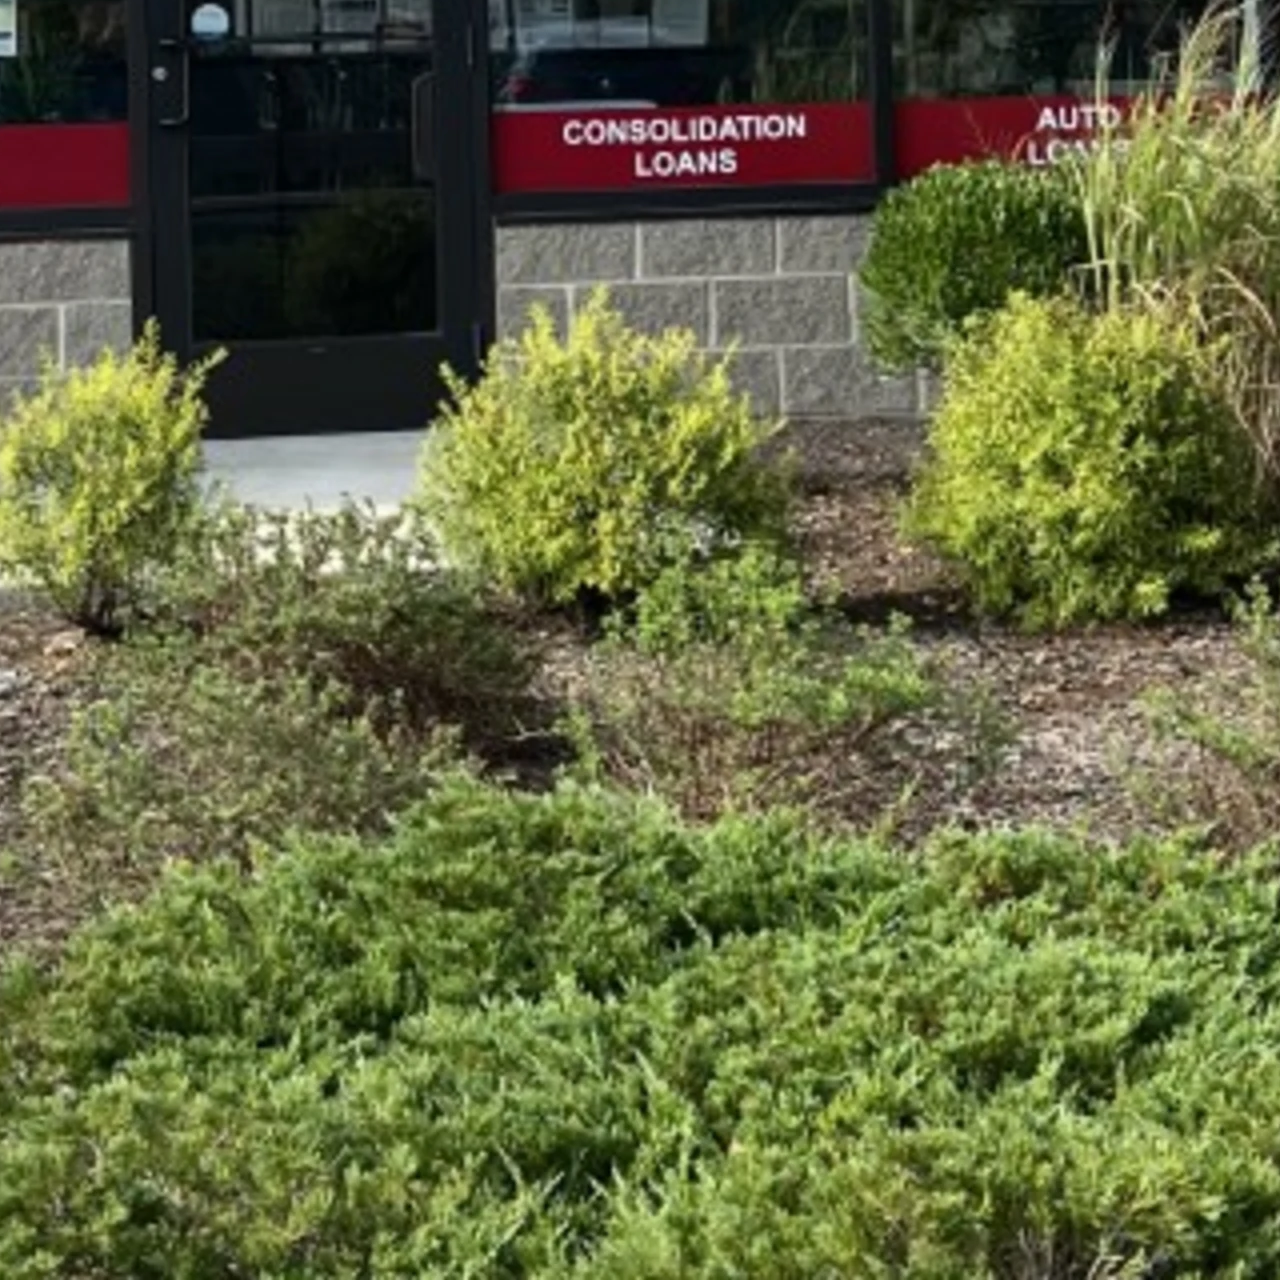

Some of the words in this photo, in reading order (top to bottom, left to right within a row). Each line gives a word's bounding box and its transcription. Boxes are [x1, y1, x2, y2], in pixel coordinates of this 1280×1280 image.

[563, 114, 806, 145] CONSOLIDATION
[1037, 104, 1121, 130] AUTO
[634, 148, 738, 177] LOANS
[1027, 139, 1131, 166] LOAS
